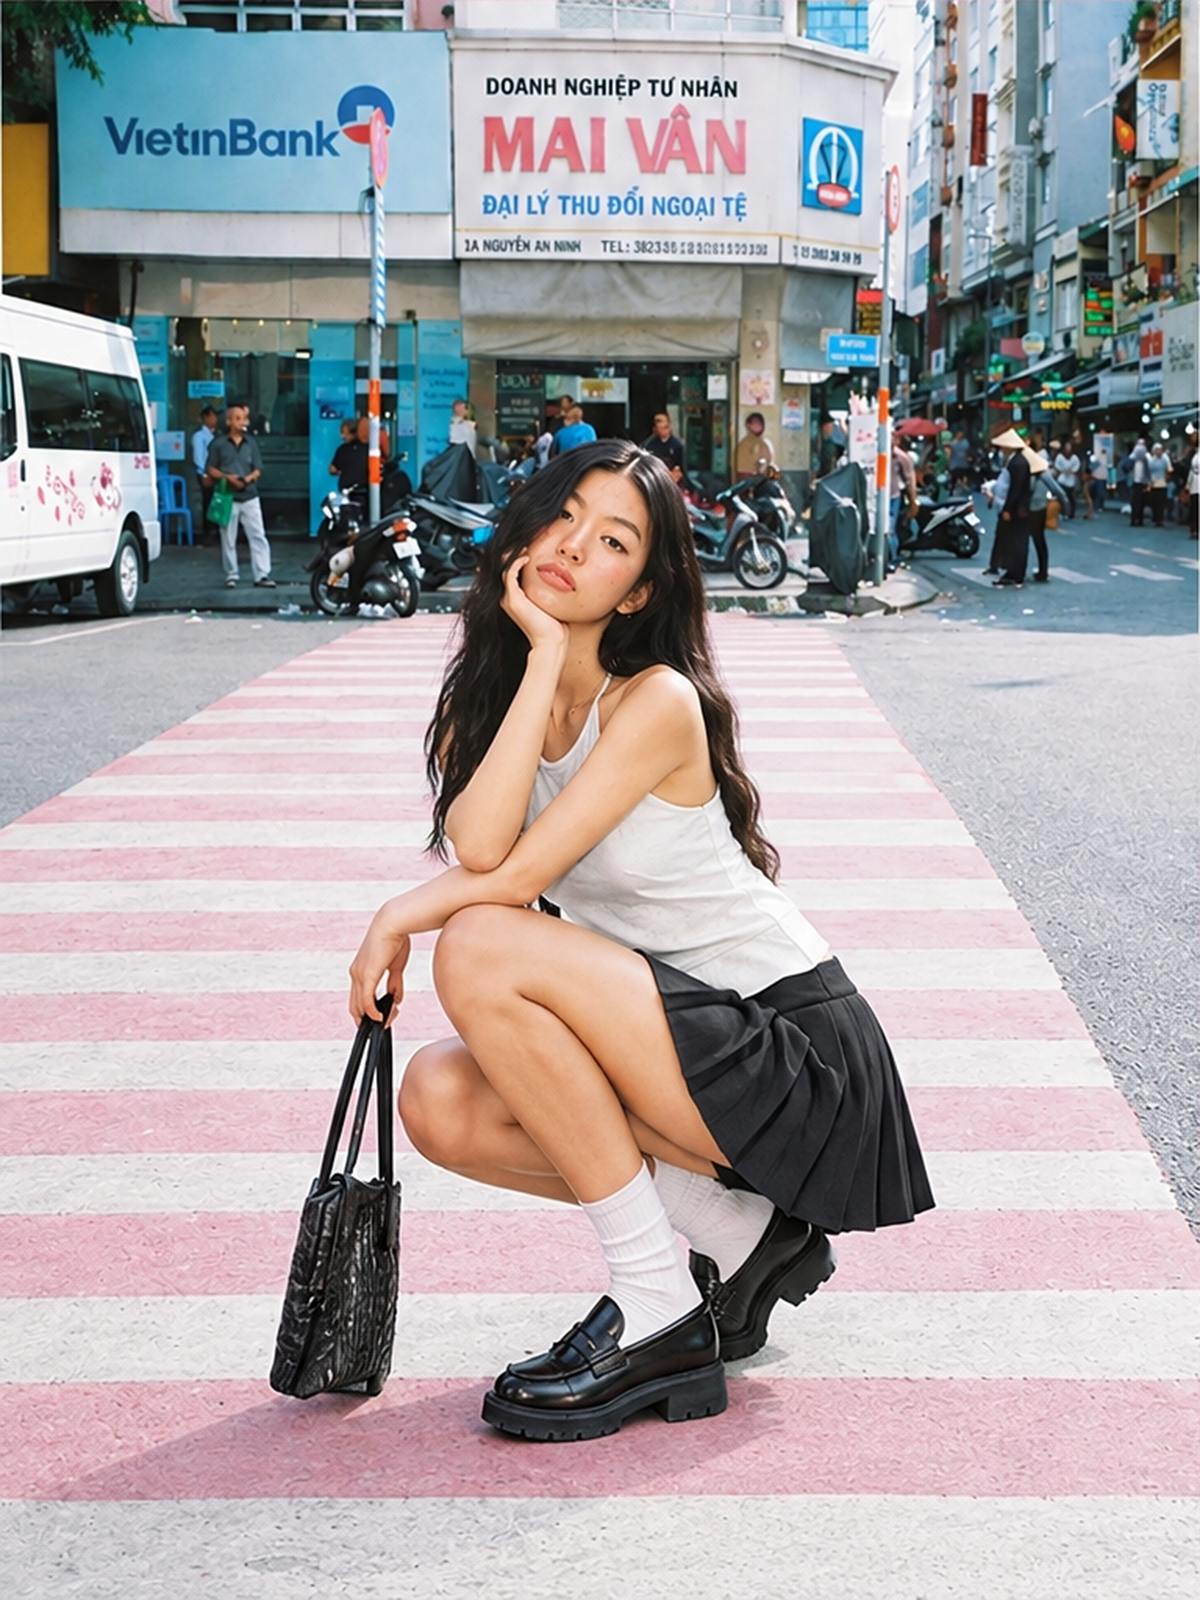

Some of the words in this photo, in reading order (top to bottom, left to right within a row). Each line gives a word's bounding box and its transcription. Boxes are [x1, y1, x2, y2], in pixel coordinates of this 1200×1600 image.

[485, 77, 557, 96] DOANH
[564, 74, 641, 102] NGHIỆP
[647, 76, 676, 98] TƯ
[681, 76, 738, 98] NHÂN
[103, 116, 340, 157] VietinBank
[483, 116, 606, 174] MAI
[625, 103, 747, 175] VÂN
[482, 194, 519, 220] ĐẠI
[526, 189, 550, 216] LÝ
[557, 195, 601, 216] THU
[606, 186, 645, 216] ĐỔI
[651, 196, 715, 222] NGOẠI
[722, 192, 748, 222] TỆ
[534, 239, 551, 253] AN
[600, 239, 630, 254] TEL:
